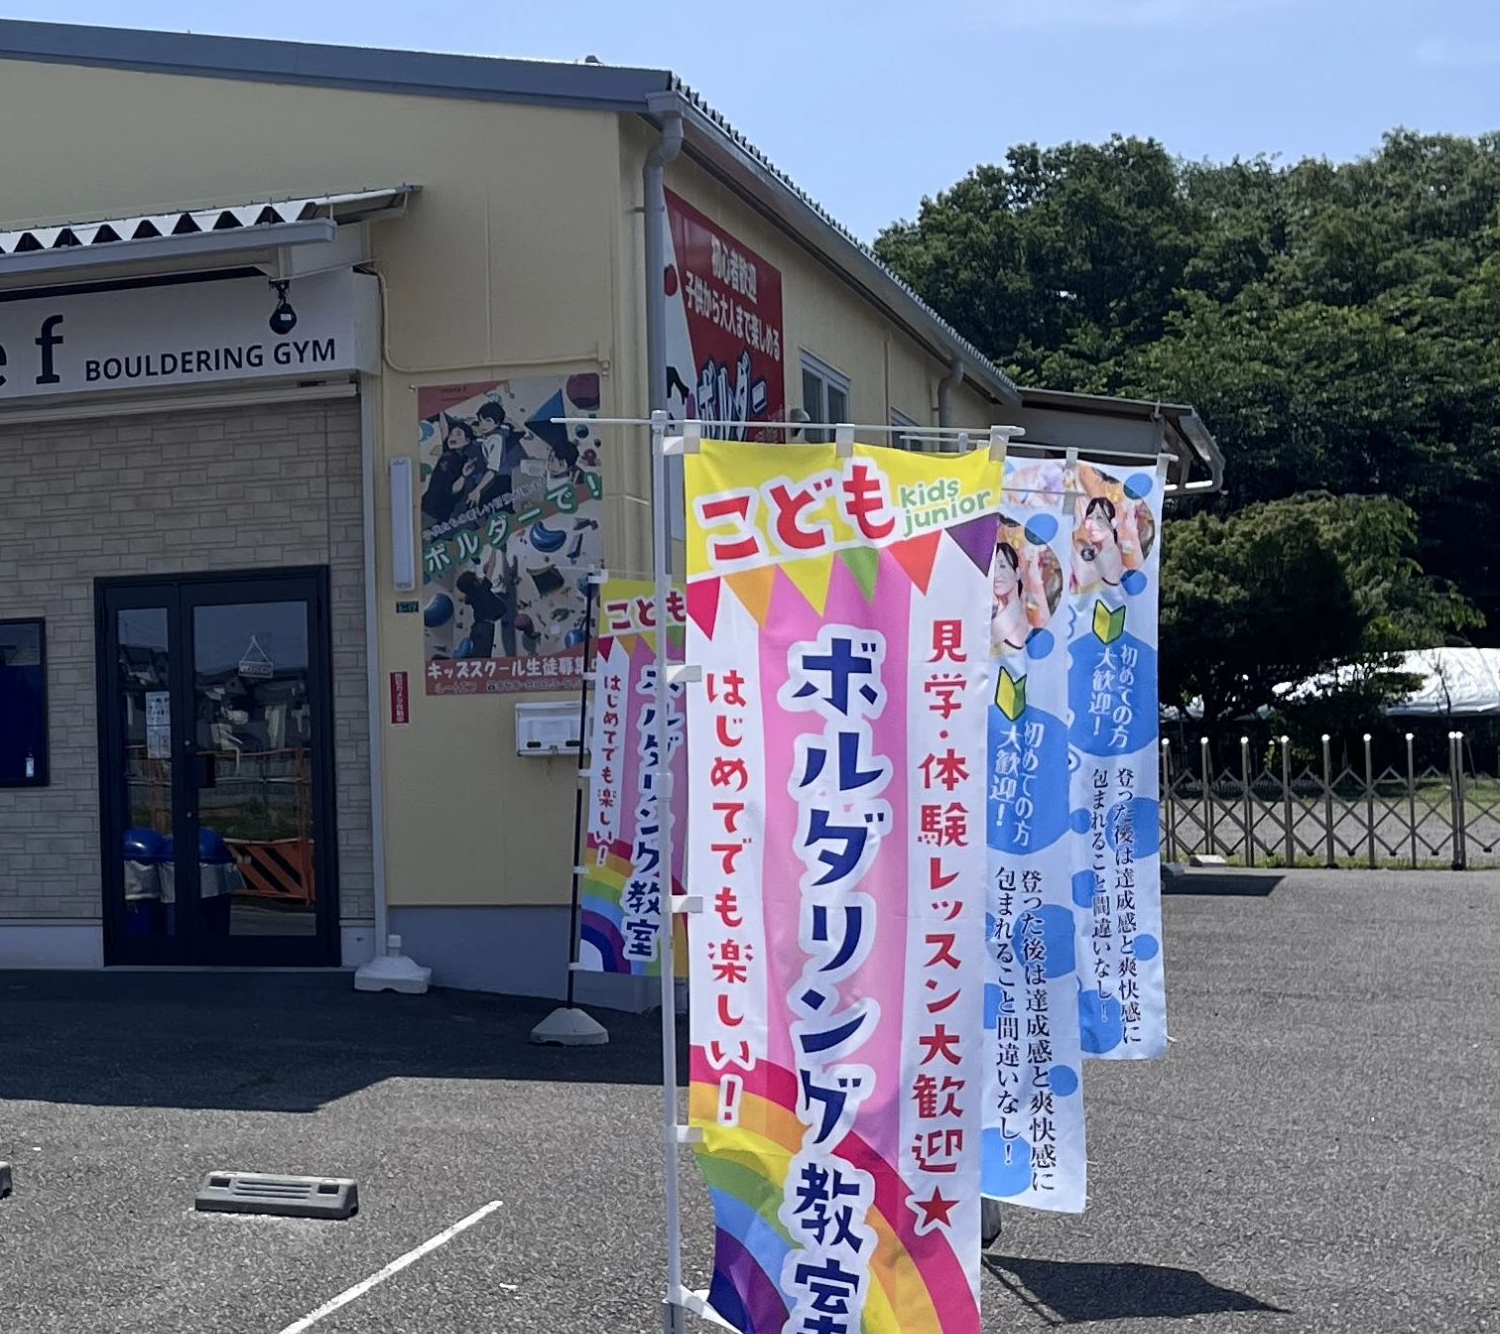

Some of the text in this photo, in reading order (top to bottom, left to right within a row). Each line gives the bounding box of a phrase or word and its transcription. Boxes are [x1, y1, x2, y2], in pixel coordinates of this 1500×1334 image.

[711, 234, 758, 304] 初心者歓迎
[35, 314, 64, 385] f
[85, 338, 336, 382] BOULDERING GYM
[424, 475, 599, 573] ボルダーで!
[702, 464, 896, 561] こども
[900, 479, 959, 508] kids
[903, 489, 991, 538] junior
[1088, 647, 1119, 736] 大歓迎!
[1108, 643, 1138, 749] 初めての方
[596, 675, 621, 865] はじめてでも楽しい!
[988, 724, 1023, 827] 大歓迎!
[1013, 720, 1046, 847] 初めての方
[706, 669, 755, 1121] はじめてでも楽しい!
[911, 618, 971, 1173] 見学・体験レッスン大歓迎
[1091, 768, 1113, 1023] 包まれること間違いなし!
[1114, 767, 1142, 1044] 登った後は達成感と爽快感に
[994, 867, 1021, 1165] 包まれること間違いなし!
[1021, 870, 1057, 1192] 登った後は達成感と爽快感に
